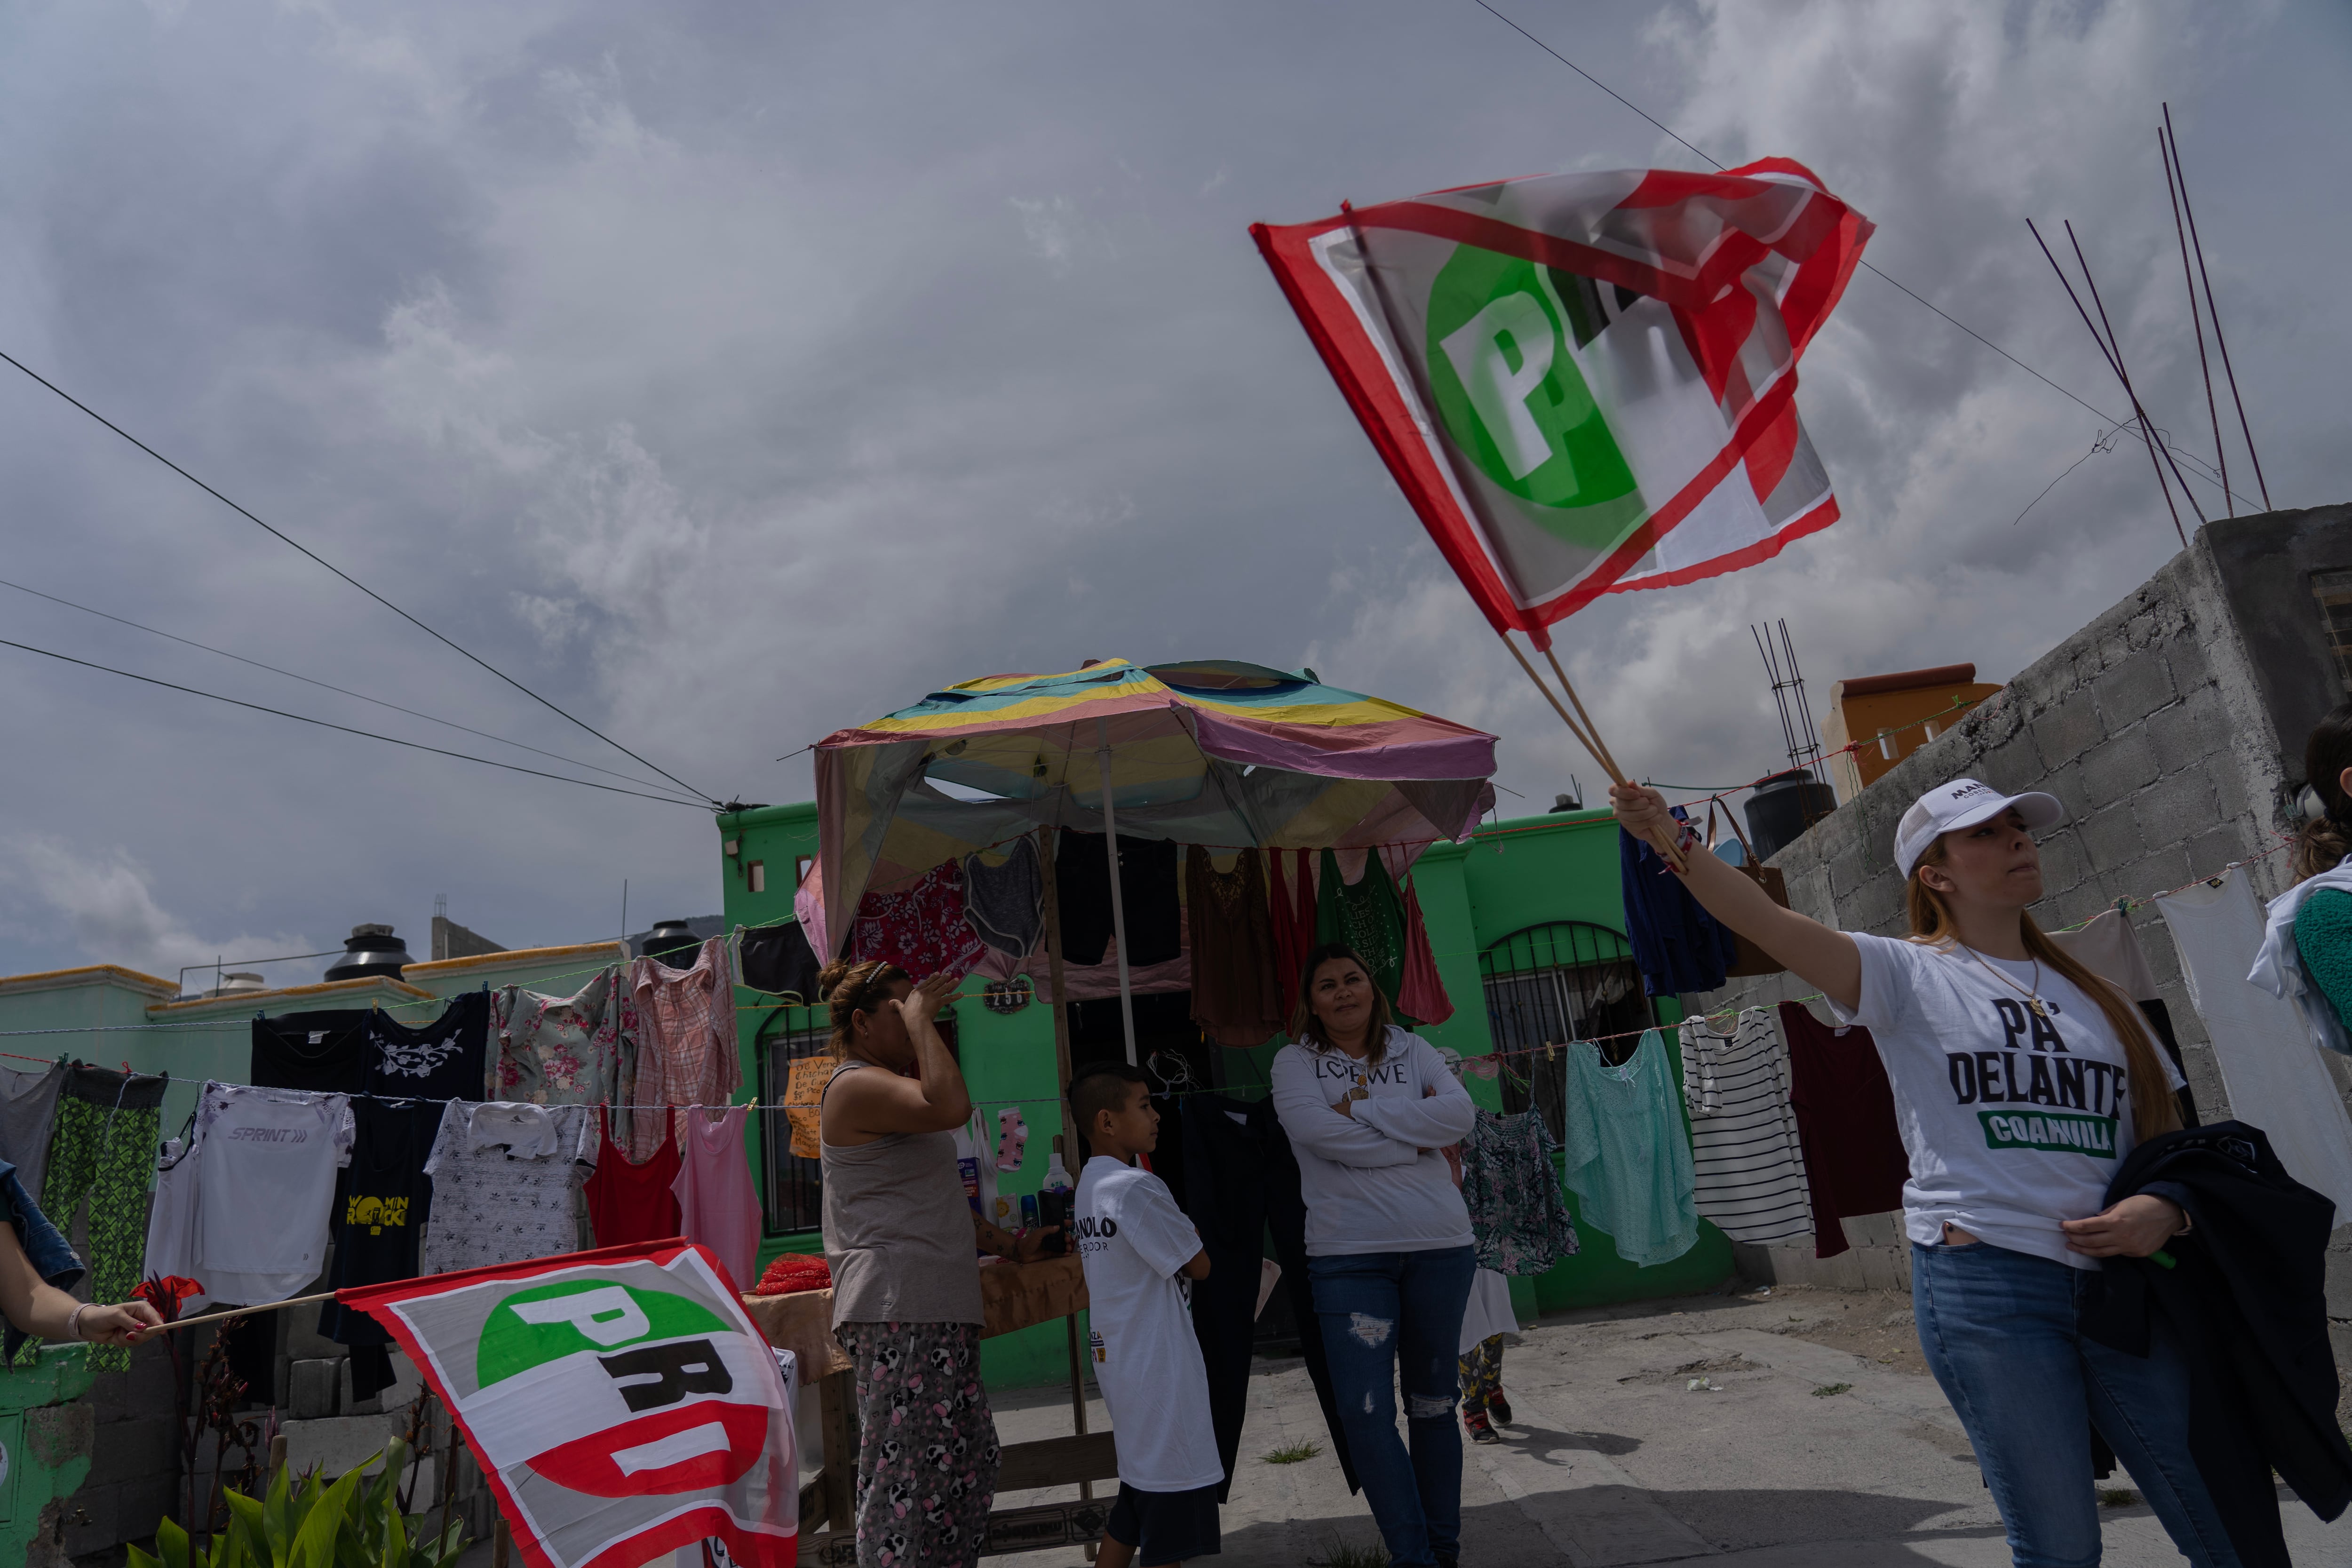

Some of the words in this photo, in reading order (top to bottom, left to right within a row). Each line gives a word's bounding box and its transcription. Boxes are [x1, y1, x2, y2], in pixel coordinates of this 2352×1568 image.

[1951, 783, 1986, 799] MAN
[813, 1059, 837, 1069] Vend
[1946, 1052, 2126, 1120] DELANTE
[228, 1127, 291, 1142] SPRINT
[1988, 1115, 2113, 1151] COAHUILA
[1075, 1217, 1117, 1240] ANOLO
[509, 1286, 734, 1478] PRI
